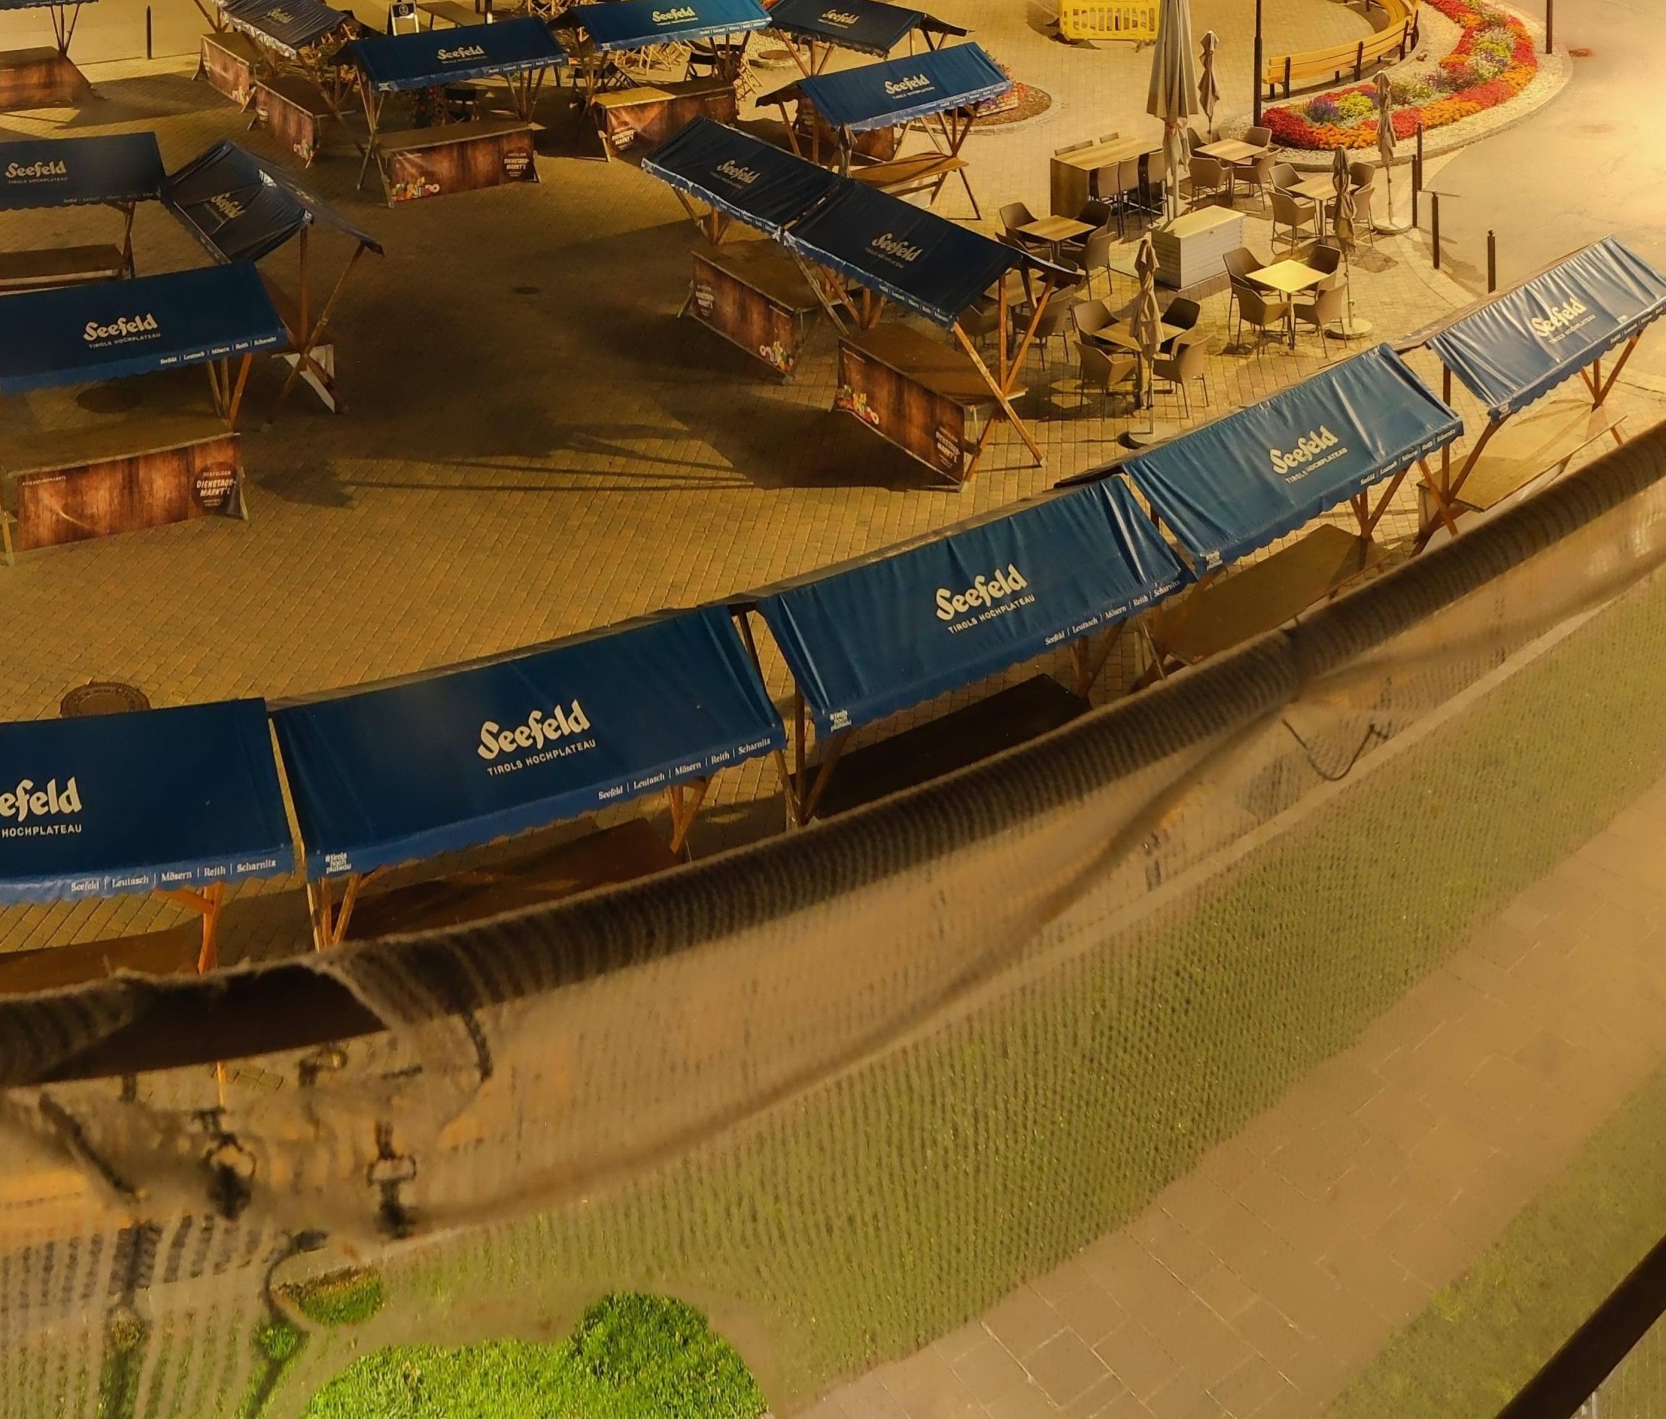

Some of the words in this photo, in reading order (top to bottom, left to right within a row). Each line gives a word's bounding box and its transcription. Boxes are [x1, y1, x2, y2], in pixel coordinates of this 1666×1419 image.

[652, 6, 696, 22] Seefeld
[437, 45, 485, 60] Seefeld
[884, 73, 930, 94] Seefeld
[4, 160, 67, 178] Seefeld
[872, 233, 923, 262] Seefeld
[83, 313, 158, 341] Seefeld
[1532, 297, 1587, 338] Seefeld
[1269, 425, 1339, 474] Seefeld
[936, 563, 1028, 621] Seefeld
[948, 617, 978, 634] TIROLS
[978, 593, 1036, 621] HOCHPLATEAU
[477, 699, 591, 760] Seefeld
[487, 759, 524, 777] TIROLS
[525, 738, 596, 765] HOCHPLATEAU
[598, 785, 624, 800] Seefeld
[633, 773, 665, 790] Leutasch
[674, 761, 702, 777] Mösern
[710, 752, 730, 766] Reith
[737, 737, 772, 755] Scharnitz
[1, 823, 83, 838] HOCHPLATEAU
[71, 879, 100, 892] Seefeld
[112, 874, 150, 888] Leutasch
[161, 869, 193, 882] Mösern
[204, 864, 228, 877] Reith
[236, 859, 278, 873] Scharnitz
